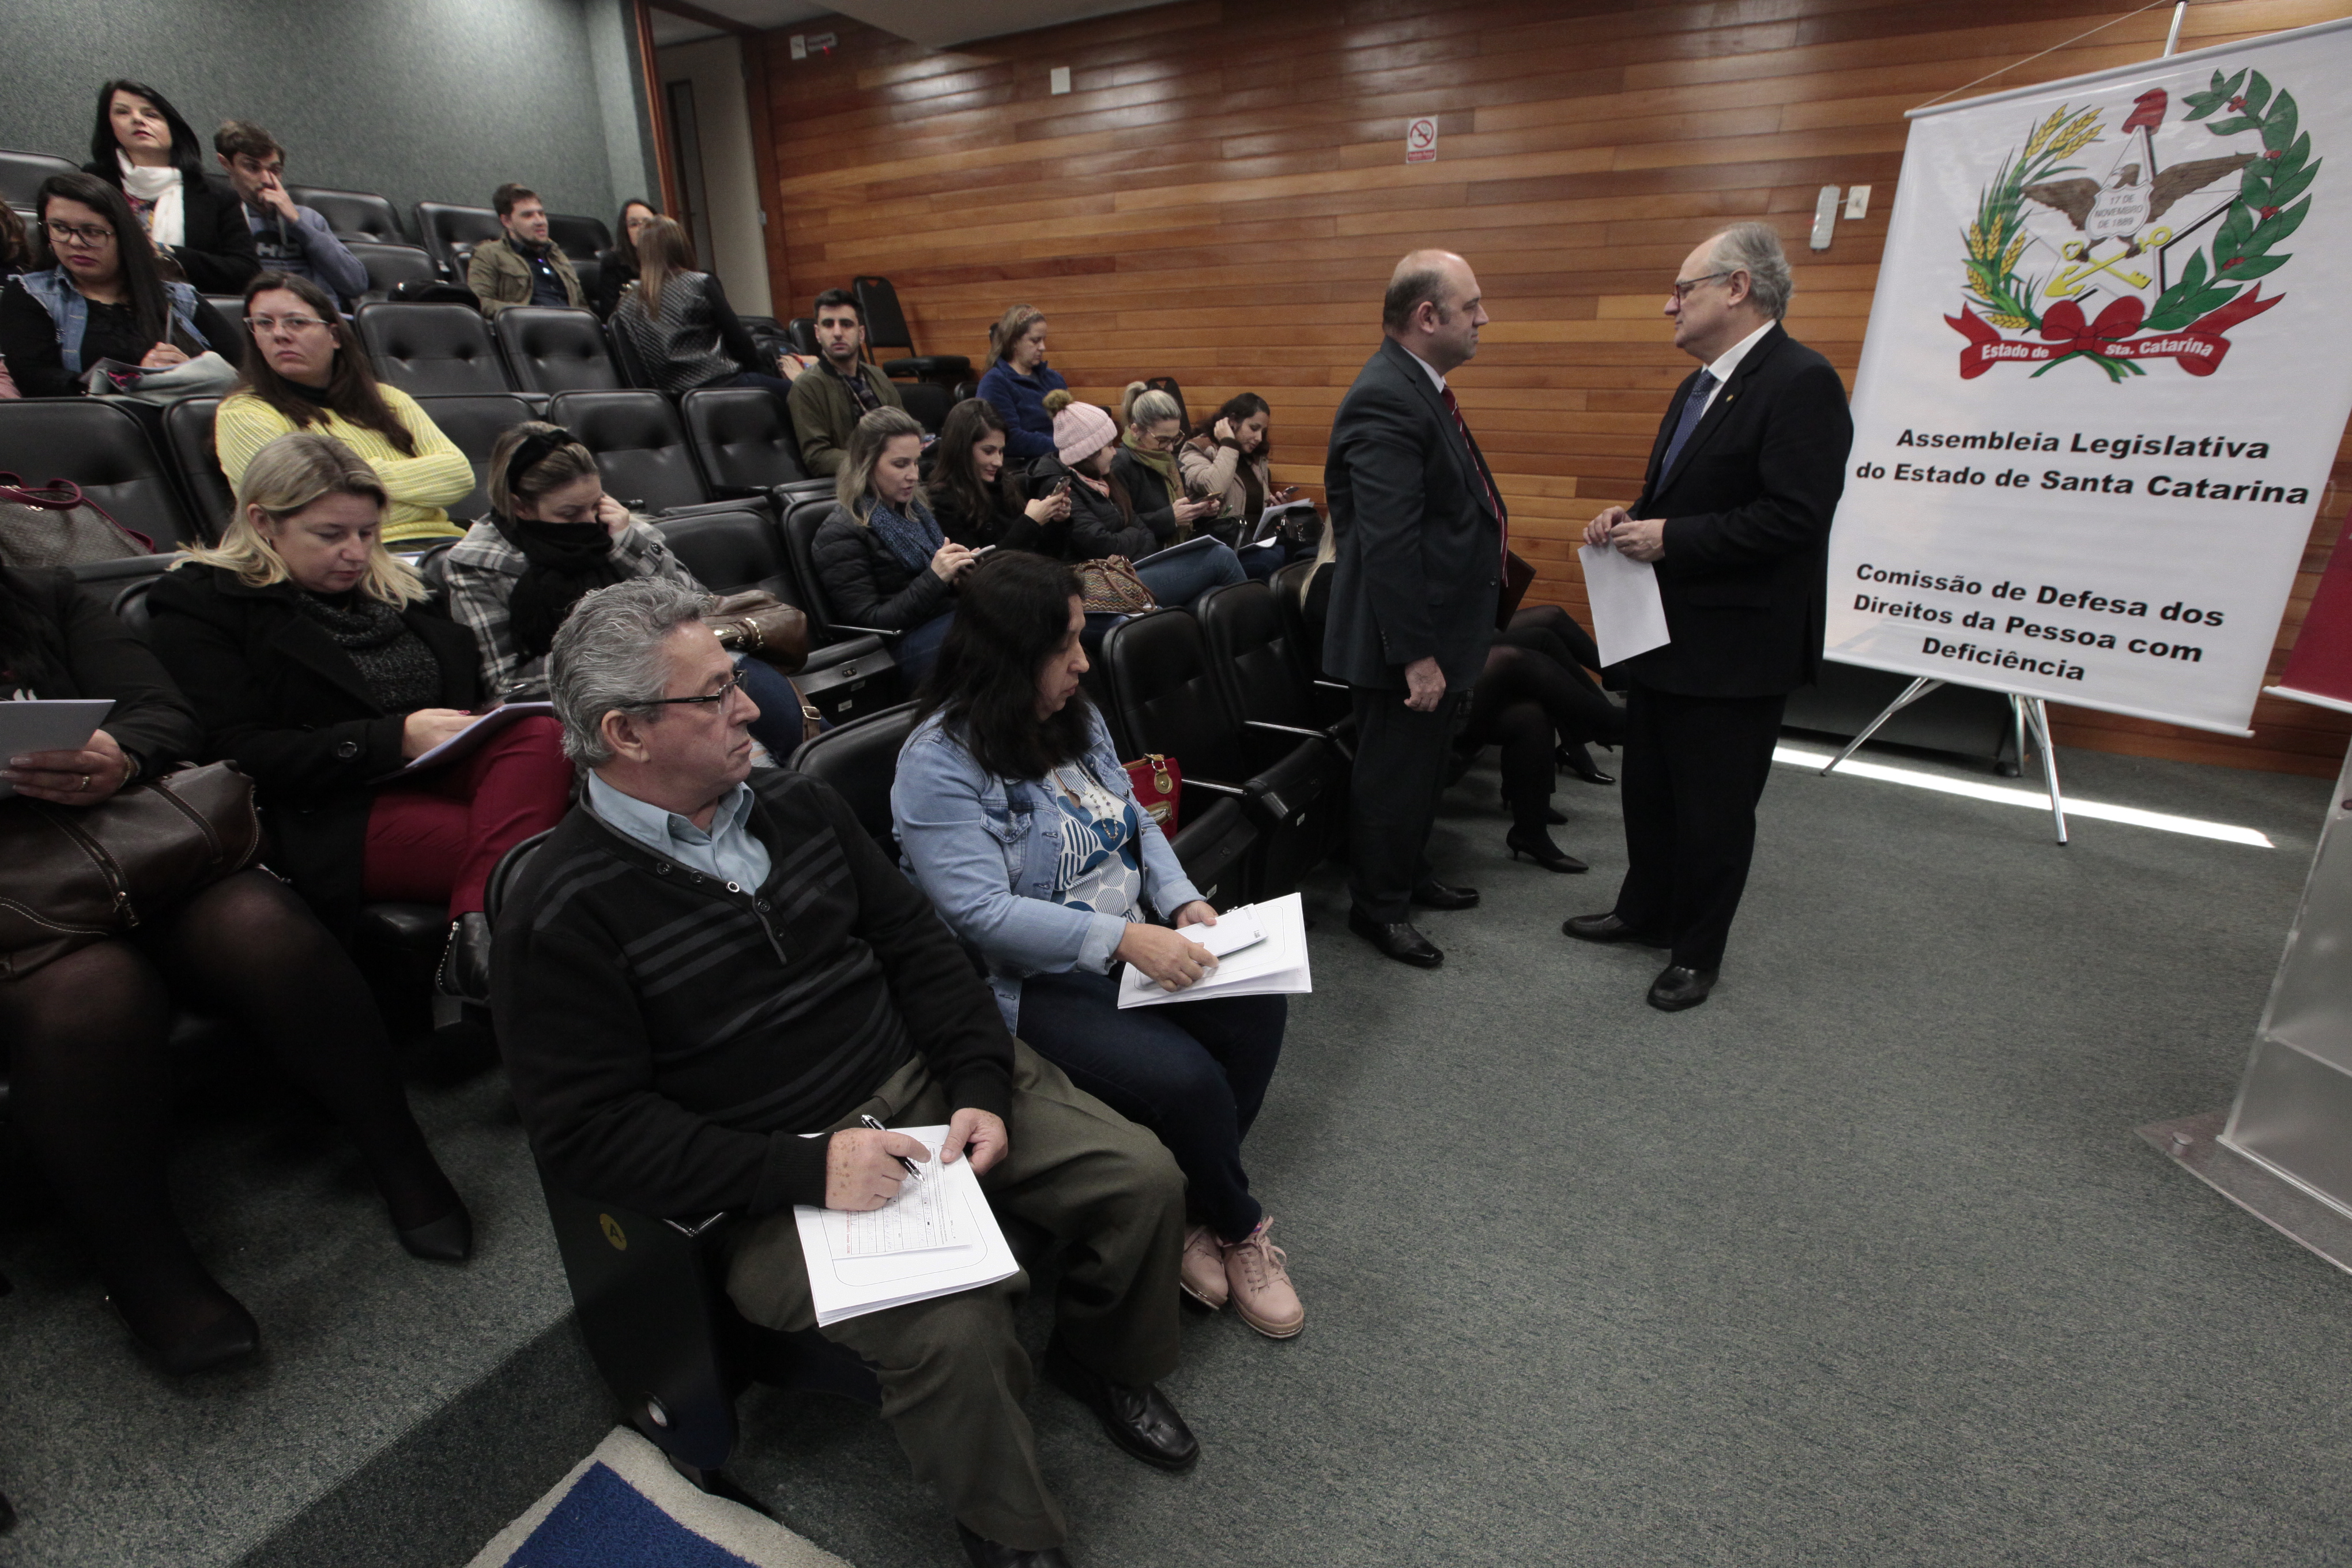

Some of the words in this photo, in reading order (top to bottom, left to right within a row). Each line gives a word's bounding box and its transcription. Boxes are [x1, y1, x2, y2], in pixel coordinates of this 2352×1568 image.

[2094, 204, 2144, 217] NOVEMBRO
[2110, 196, 2121, 205] 17
[2122, 194, 2135, 203] DE
[2097, 219, 2111, 229] DE
[2112, 217, 2134, 227] 1889
[1981, 344, 2028, 360] Estado
[2031, 347, 2050, 359] de
[2105, 344, 2135, 355] Sta.
[2139, 337, 2214, 357] Catarina
[1897, 430, 2059, 451] Assembleia
[2071, 434, 2269, 459] Legislativa
[1857, 462, 1885, 478] do
[1895, 464, 1985, 485] Estado
[1996, 469, 2029, 488] de
[2041, 471, 2134, 493] Santa
[2148, 476, 2308, 504] Catarina
[1857, 564, 1982, 595] Comissão
[1992, 581, 2026, 600] de
[2037, 586, 2147, 616] Defesa
[2161, 602, 2223, 626] dos
[1854, 595, 1952, 623] Direitos
[1962, 612, 1995, 630] da
[2006, 616, 2116, 649] Pessoa
[2128, 639, 2202, 662] com
[1923, 638, 2084, 680] Deficiência
[609, 1223, 623, 1243] A
